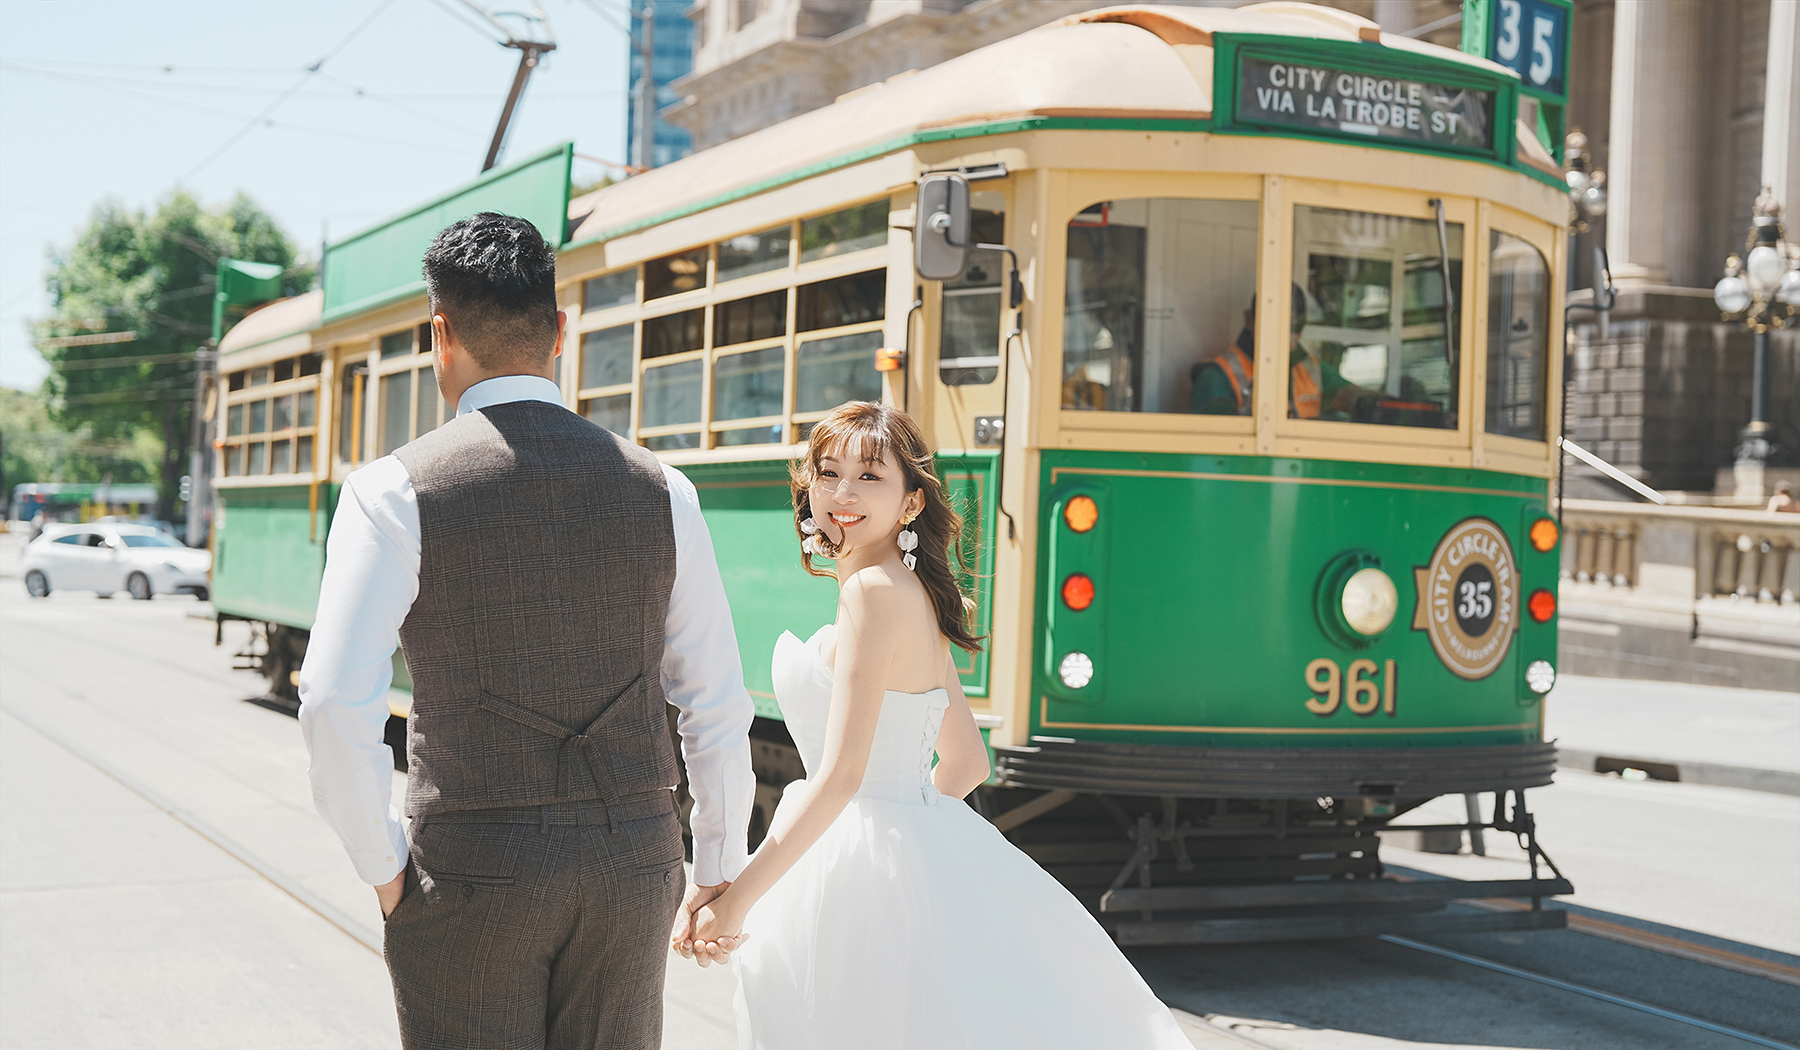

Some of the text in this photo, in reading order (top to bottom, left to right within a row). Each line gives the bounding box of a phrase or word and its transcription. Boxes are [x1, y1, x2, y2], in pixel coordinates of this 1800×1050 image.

[1496, 0, 1554, 86] 35
[1257, 86, 1461, 135] VIA LA TROBE ST
[1268, 63, 1327, 94] CITY
[1336, 73, 1423, 106] CIRCLE
[1434, 533, 1512, 624] CITY CIRCLE TRAM
[1458, 580, 1492, 619] 35
[1304, 657, 1397, 718] 961
